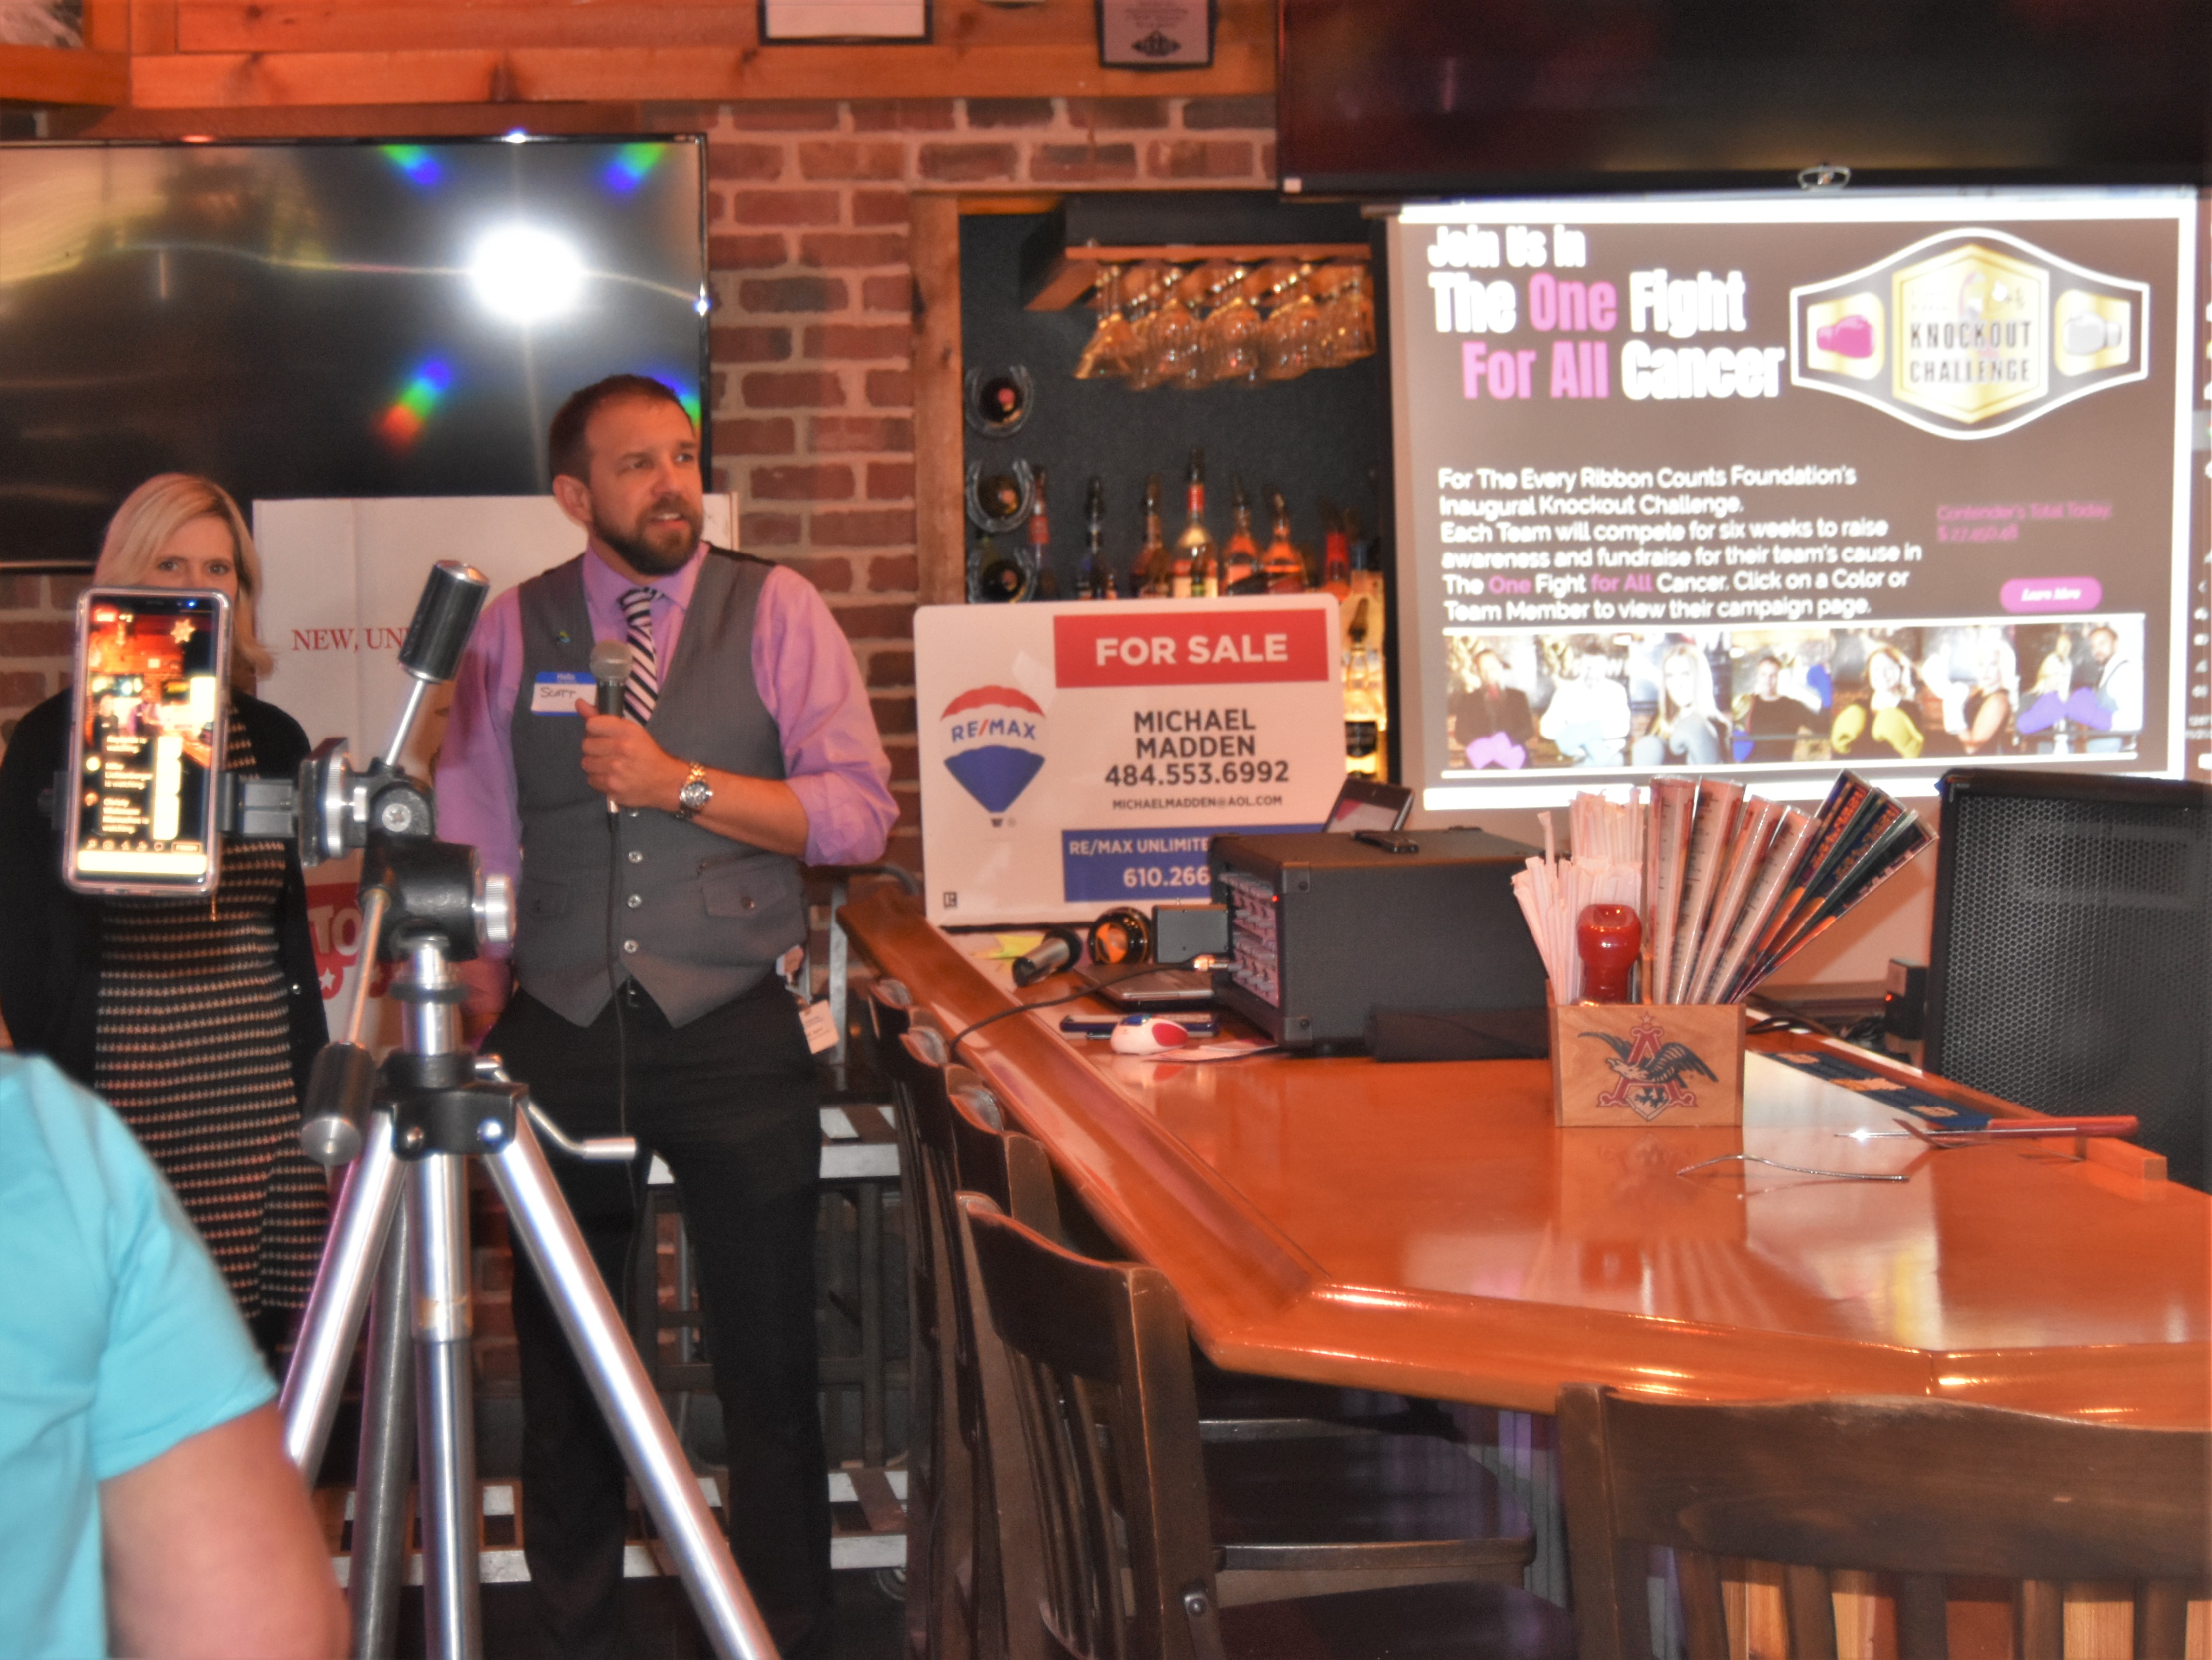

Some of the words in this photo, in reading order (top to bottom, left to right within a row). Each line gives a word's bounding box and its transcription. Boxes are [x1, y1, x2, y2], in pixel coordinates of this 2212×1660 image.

[1427, 224, 1499, 267] Join
[1506, 226, 1547, 267] Us
[1554, 224, 1586, 267] in
[1428, 272, 1516, 332] The
[1529, 272, 1617, 332] One
[1629, 269, 1746, 338] Fight
[1910, 322, 2031, 349] KNOCKOUT
[1462, 341, 1536, 398] For
[1549, 341, 1609, 398] All
[1621, 339, 1785, 400] Cancer
[1909, 359, 2029, 383] CHALLENGE
[1438, 468, 1473, 490] For
[1476, 468, 1518, 490] The
[1520, 468, 1577, 493] Every
[1580, 468, 1654, 489] Ribbon
[1656, 467, 1727, 488] Counts
[1730, 465, 1857, 487] Foundation's
[1439, 495, 1536, 522] Inaugural
[1539, 495, 1636, 516] Knockout
[1639, 494, 1744, 518] Challenge.
[1441, 521, 1492, 543] Each
[1496, 522, 1551, 542] Team
[1555, 521, 1590, 542] will
[1593, 521, 1685, 547] compete
[1689, 519, 1715, 541] for
[1719, 519, 1745, 540] six
[1748, 518, 1813, 538] weeks
[1817, 517, 1838, 537] to
[1841, 517, 1889, 537] raise
[1441, 552, 1550, 569] awareness
[1554, 548, 1593, 567] and
[1597, 547, 1691, 567] fundraise
[1695, 546, 1721, 566] for
[1725, 545, 1770, 565] their
[1772, 544, 1838, 564] team's
[1841, 545, 1900, 563] cause
[1904, 542, 1922, 562] in
[1443, 574, 1484, 595] The
[1488, 575, 1531, 594] One
[1535, 573, 1586, 599] Fight
[1591, 573, 1620, 592] for
[1624, 573, 1653, 593] All
[1656, 572, 1730, 593] Cancer.
[1733, 569, 1782, 591] Click
[1785, 572, 1812, 590] on
[1815, 572, 1828, 589] a
[1831, 568, 1885, 589] Color
[1887, 570, 1910, 588] or
[1444, 600, 1501, 622] Team
[1505, 600, 1590, 621] Member
[1593, 599, 1615, 619] to
[1618, 598, 1666, 619] view
[1668, 597, 1715, 618] their
[1716, 596, 1813, 621] campaign
[1817, 597, 1872, 620] page.
[292, 628, 358, 653] NEW,
[364, 628, 410, 650] UN
[1096, 637, 1177, 666] FOR
[1188, 633, 1288, 665] SALE
[951, 718, 1037, 743] RE/MAX
[1134, 709, 1256, 733] MICHAEL
[1136, 735, 1255, 759] MADDEN
[1105, 761, 1289, 787] 484.553.6992
[1112, 795, 1282, 810] MICHAELMADDEN@AOL.COM
[1069, 839, 1133, 857] RE/MAX
[1137, 837, 1209, 853] UNLIMITE
[1124, 866, 1211, 888] 610.266
